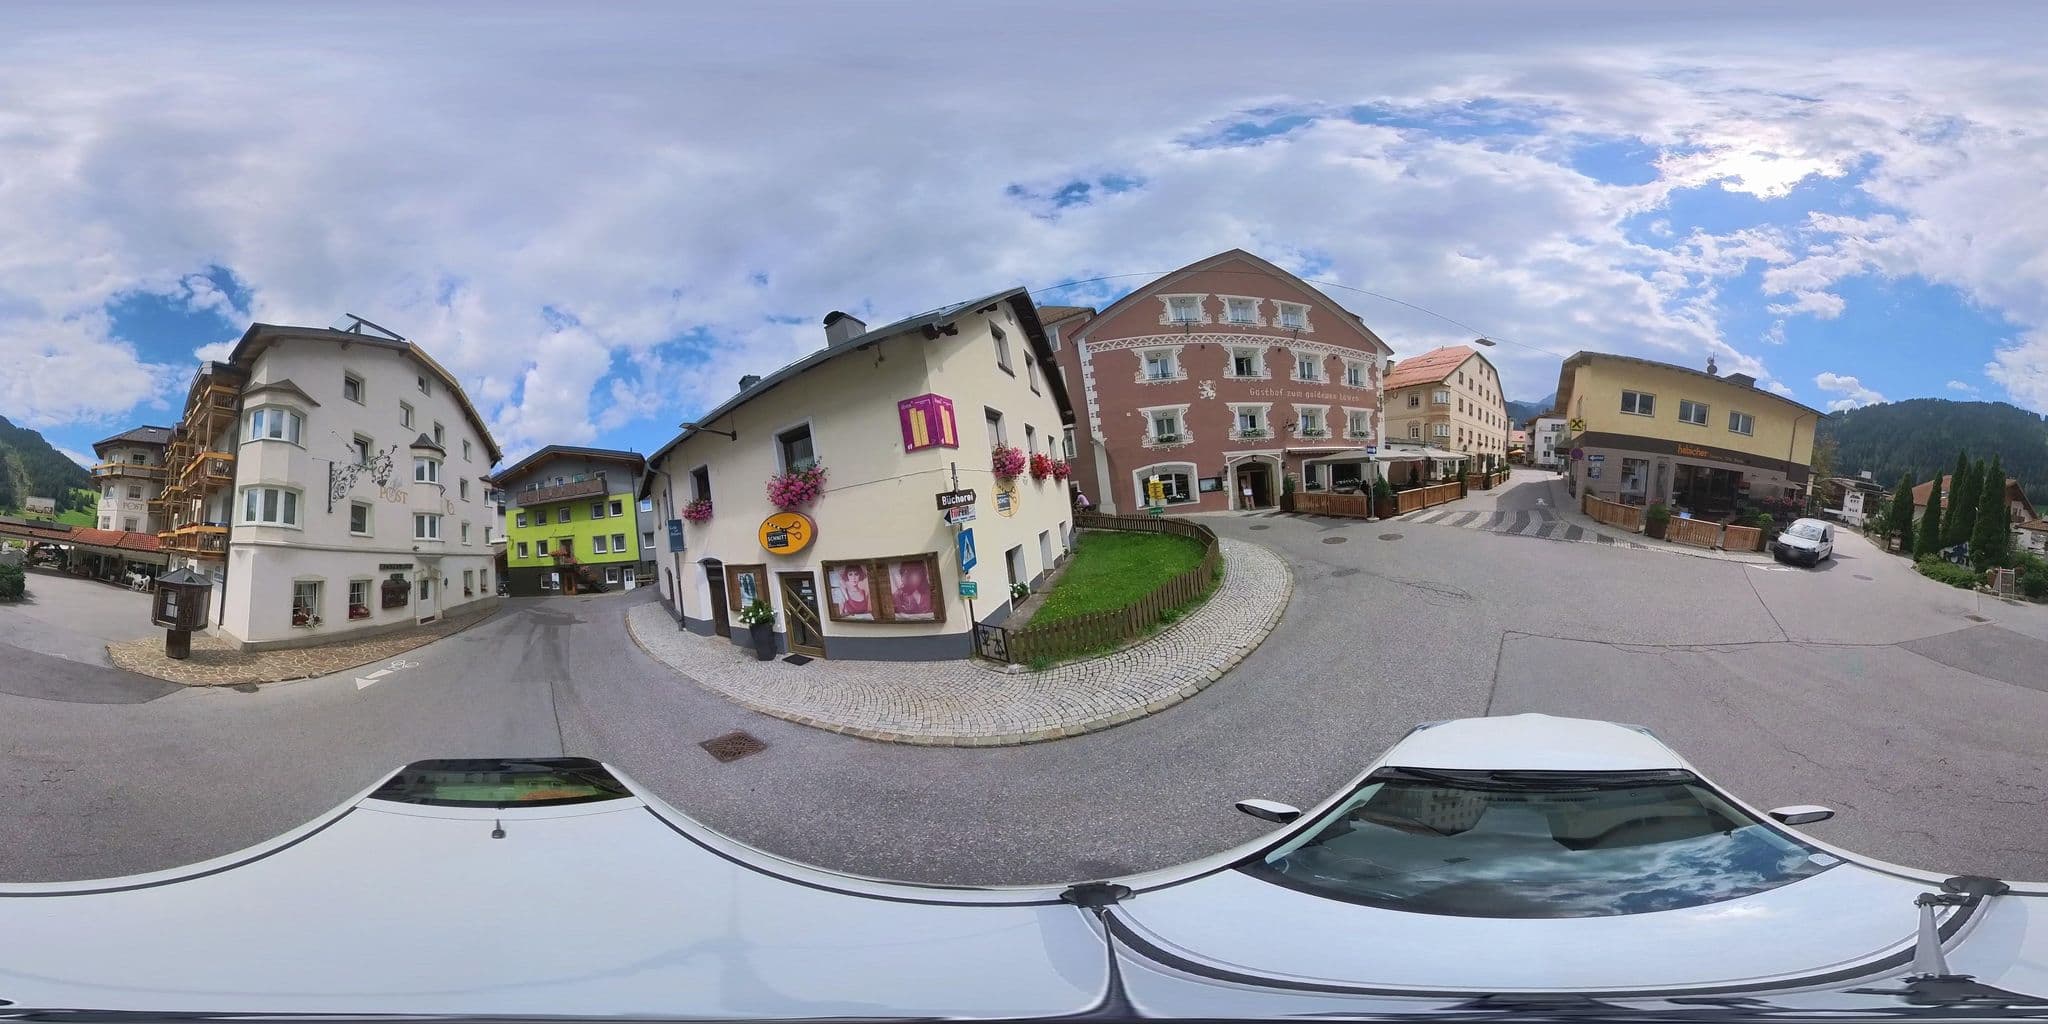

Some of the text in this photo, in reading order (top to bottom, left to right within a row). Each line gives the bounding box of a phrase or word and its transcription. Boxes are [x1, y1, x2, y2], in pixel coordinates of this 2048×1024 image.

[1249, 387, 1284, 397] Gasthof
[1287, 390, 1302, 398] zum
[379, 486, 408, 504] POST
[941, 491, 974, 506] Bücherei
[122, 502, 144, 511] POST
